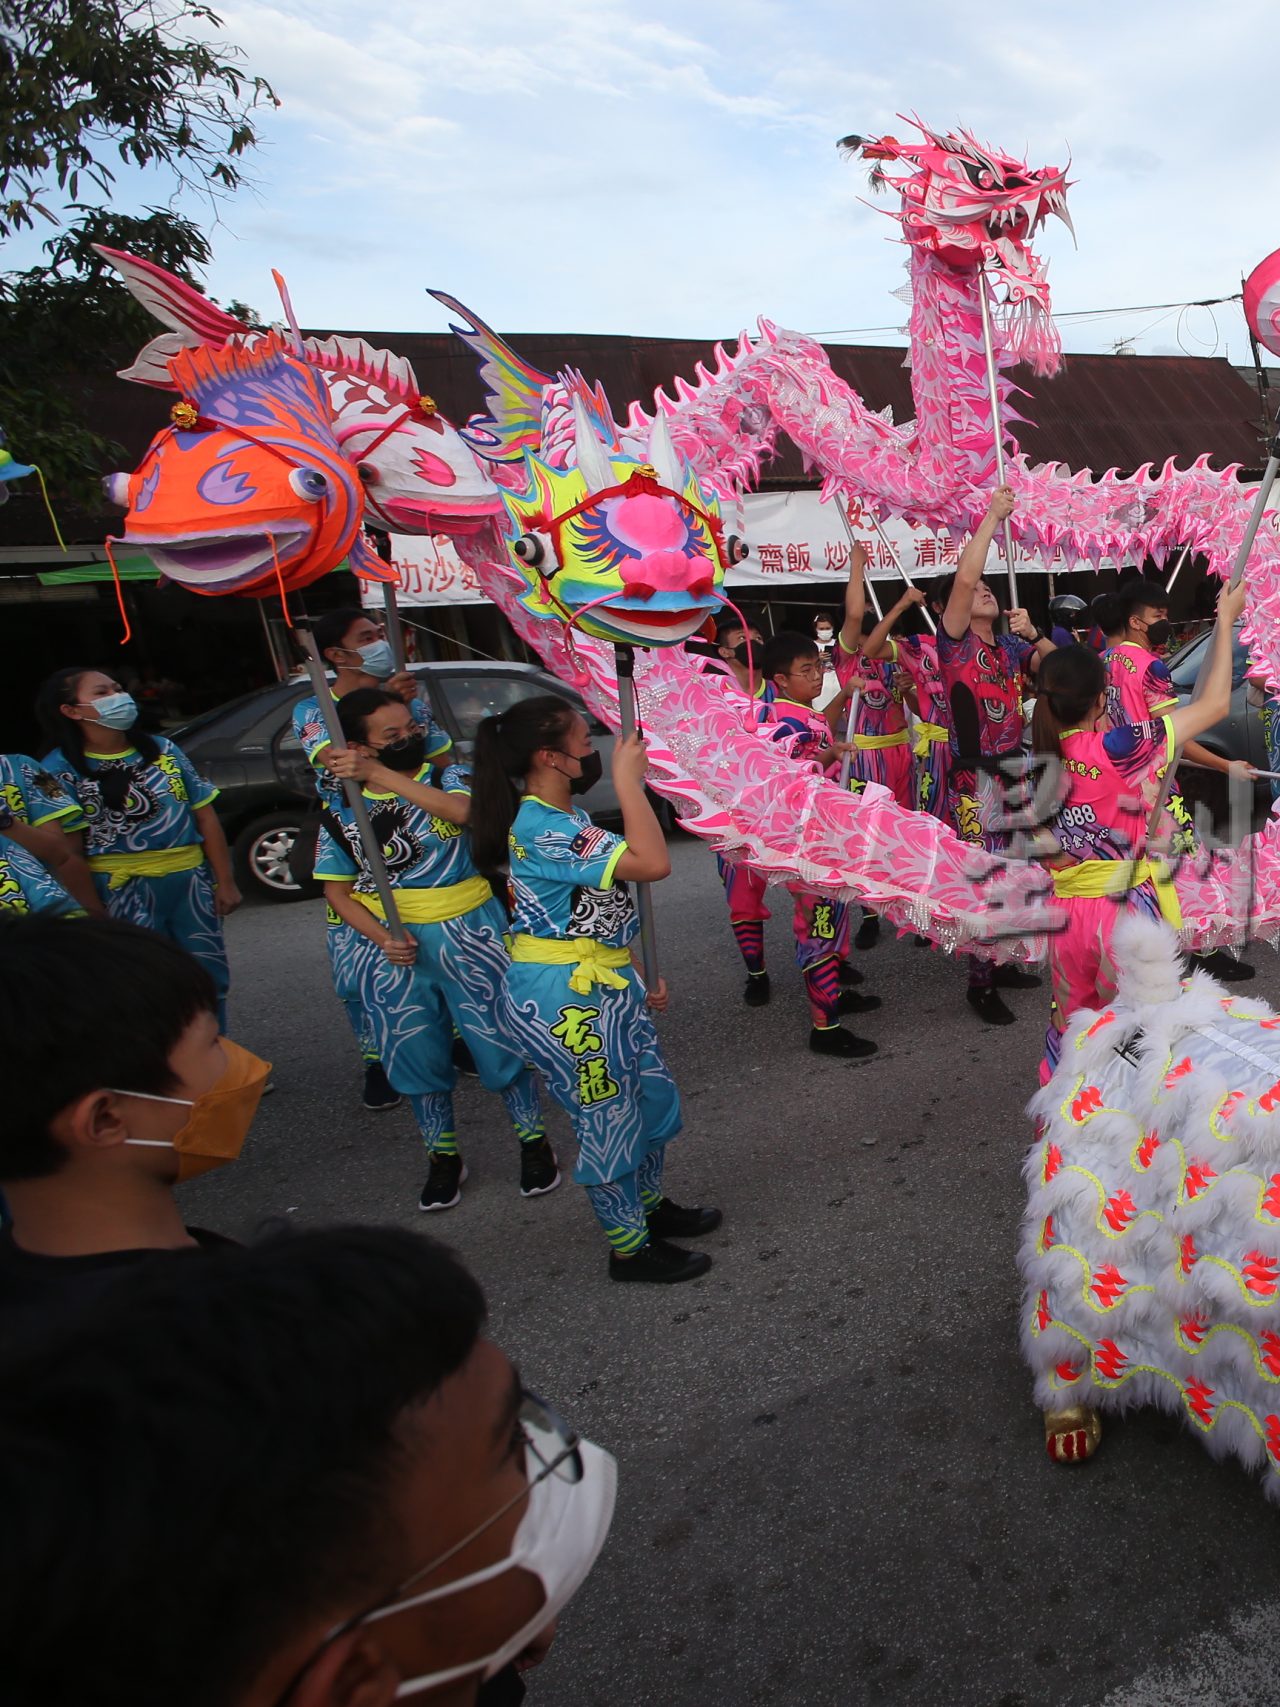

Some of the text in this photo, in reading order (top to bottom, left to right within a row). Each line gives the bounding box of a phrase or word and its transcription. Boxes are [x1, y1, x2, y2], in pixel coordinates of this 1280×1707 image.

[757, 543, 813, 573] 齋飯
[1060, 828, 1110, 852] 美食中心
[550, 1007, 619, 1105] 玄龍
